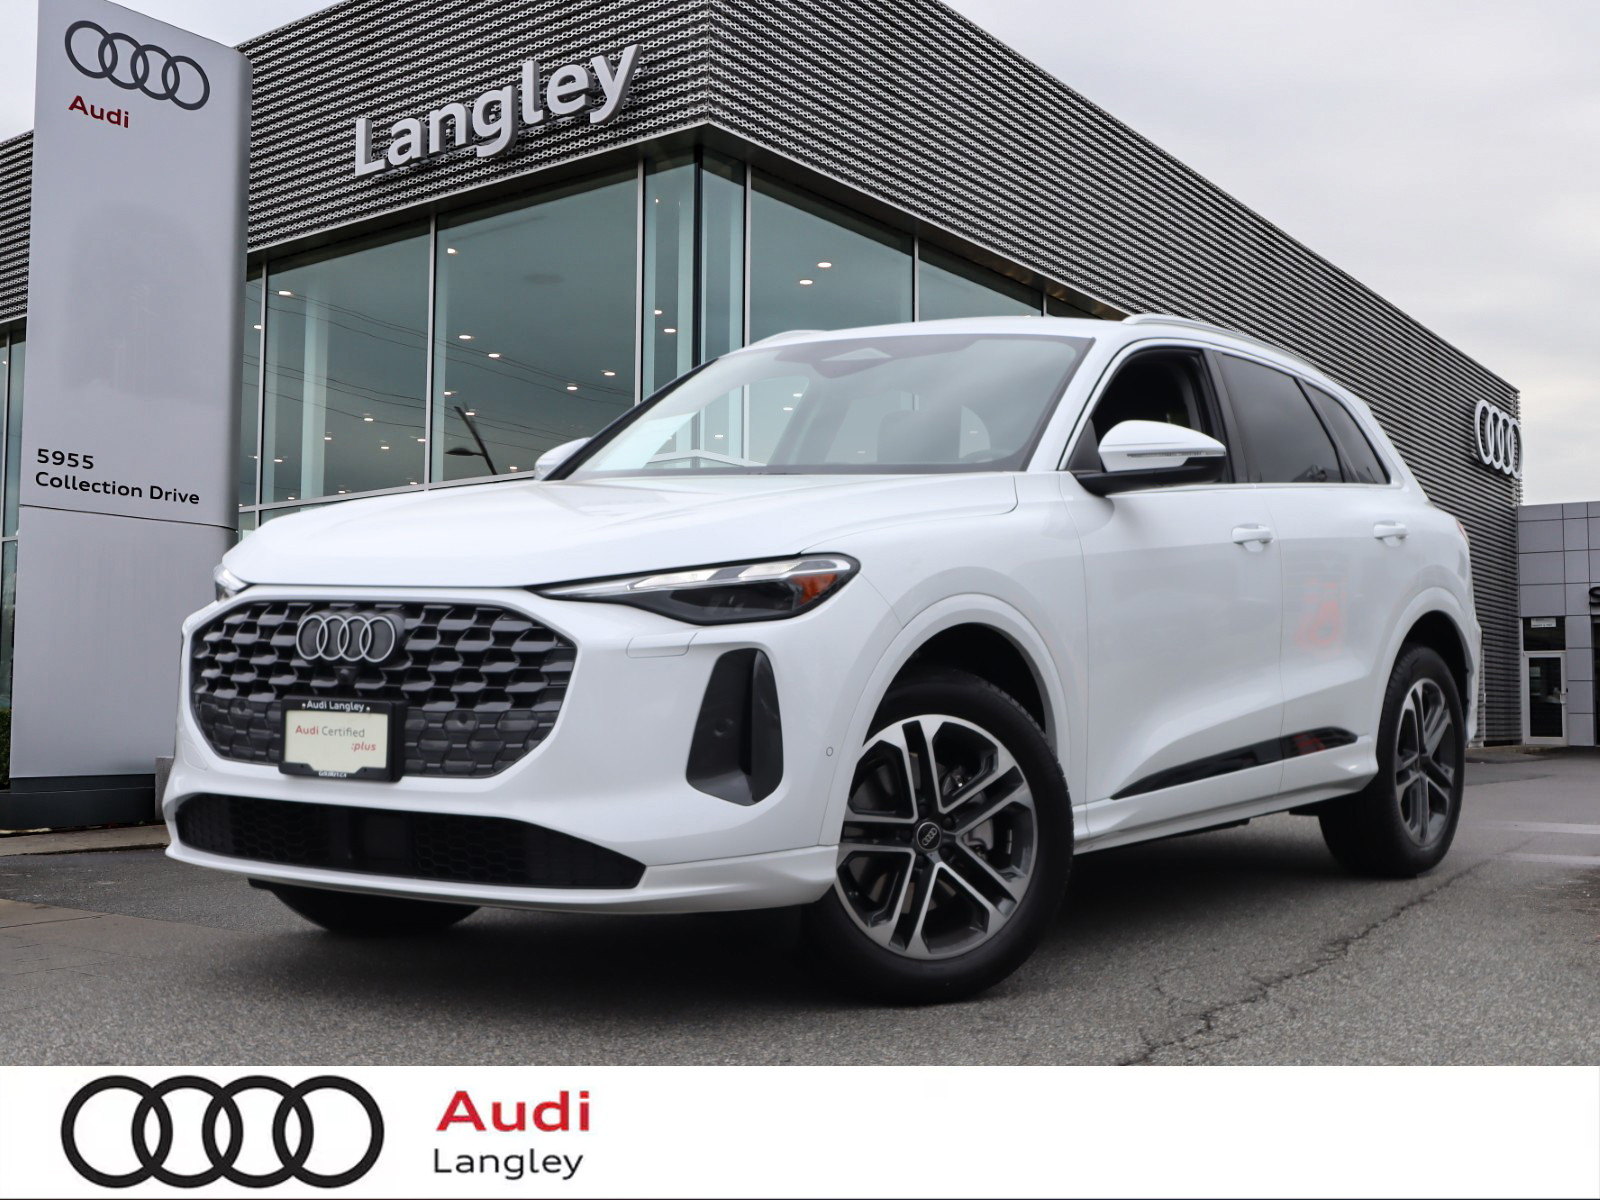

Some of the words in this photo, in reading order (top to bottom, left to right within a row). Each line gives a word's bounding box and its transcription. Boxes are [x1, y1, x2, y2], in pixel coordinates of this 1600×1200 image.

[69, 95, 129, 128] Audi
[355, 44, 642, 176] Langley
[37, 448, 94, 469] 5955
[35, 472, 142, 498] Collection
[150, 485, 200, 504] Drive
[307, 701, 327, 709] Audi
[329, 702, 364, 712] Langley
[295, 725, 319, 735] Audi
[321, 726, 365, 738] Certified
